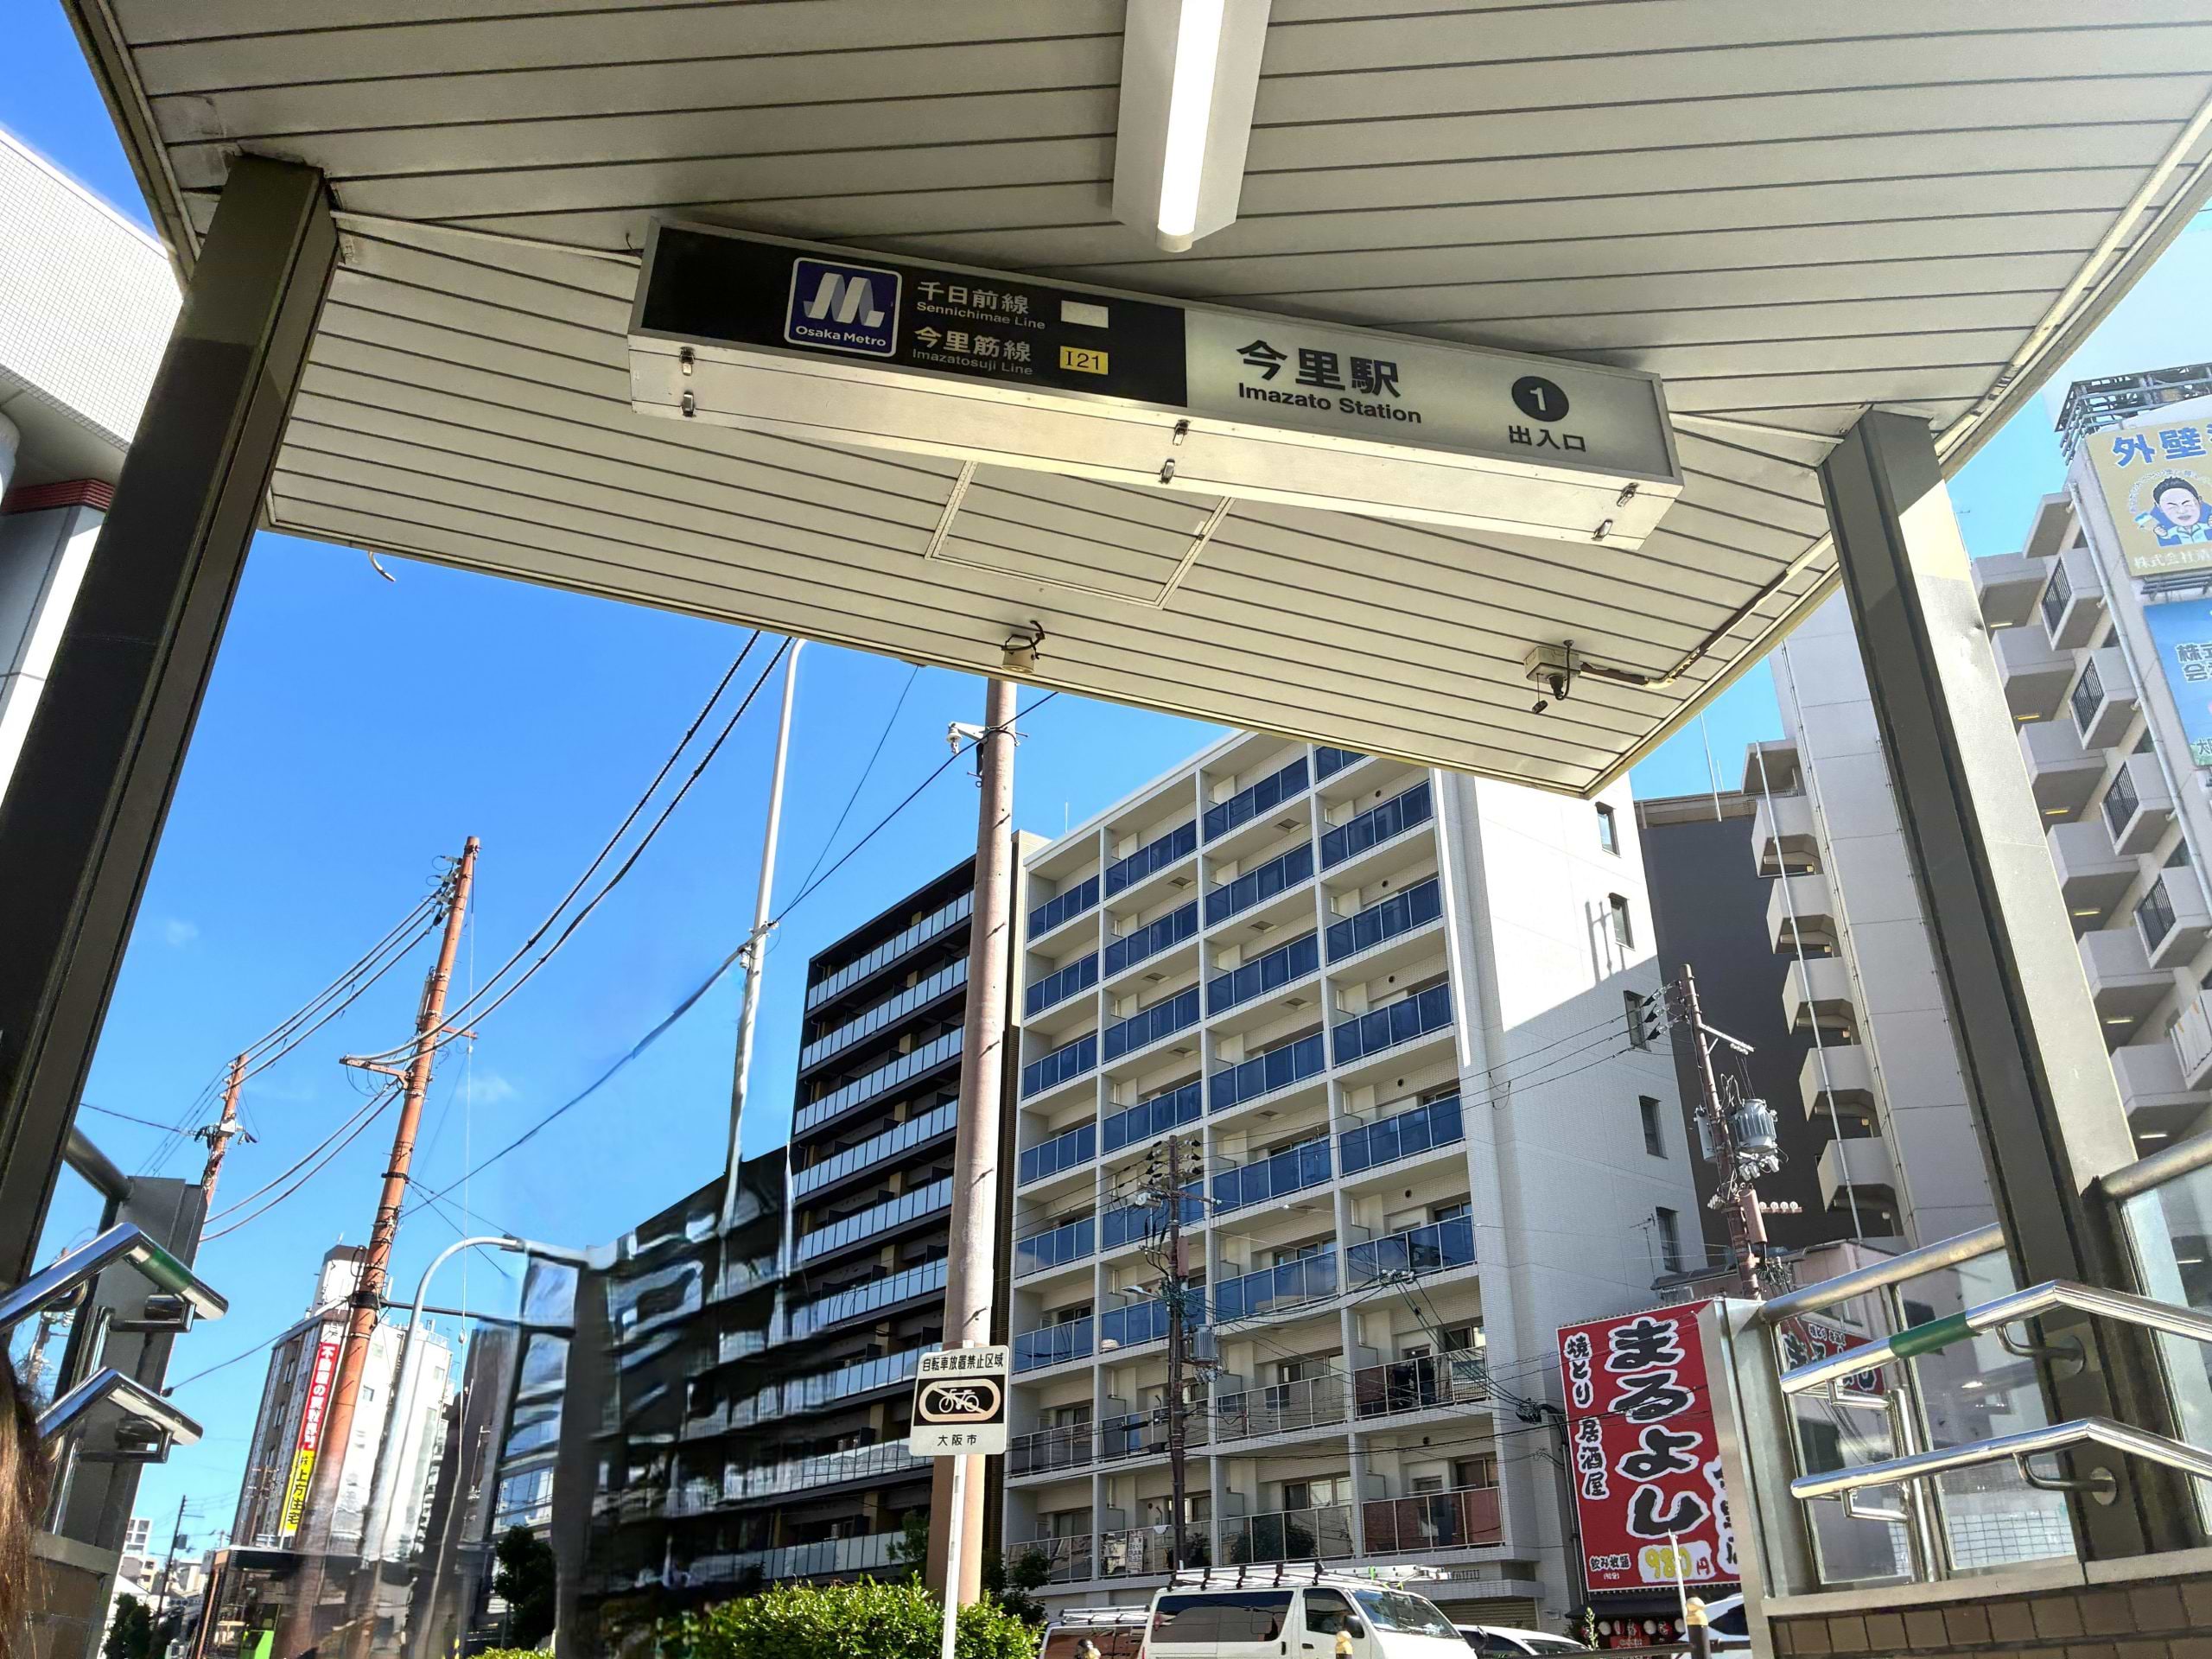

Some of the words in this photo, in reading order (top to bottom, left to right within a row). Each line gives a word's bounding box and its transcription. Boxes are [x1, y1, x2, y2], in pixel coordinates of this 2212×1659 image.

[917, 281, 1029, 315] 千日前線
[916, 302, 1011, 324] Sennichimae
[1014, 316, 1046, 330] Line
[795, 325, 841, 340] Osaka
[843, 332, 887, 346] Metro
[913, 326, 1032, 363] 今里筋線
[912, 348, 996, 372] Imazatosuji
[1001, 362, 1033, 376] Line
[1065, 350, 1099, 371] I21
[1236, 340, 1402, 399] 今里駅
[1238, 382, 1332, 412] Imazato
[1338, 397, 1422, 425] Station
[1529, 385, 1548, 412] 1
[1508, 423, 1587, 454] 出入口
[922, 1351, 1004, 1372] 自転車放置禁止区域
[1566, 1334, 1592, 1406] 焼とり
[937, 1433, 977, 1447] 大阪市
[1610, 1319, 1706, 1536] まるよし
[1579, 1419, 1607, 1497] 居酒屋
